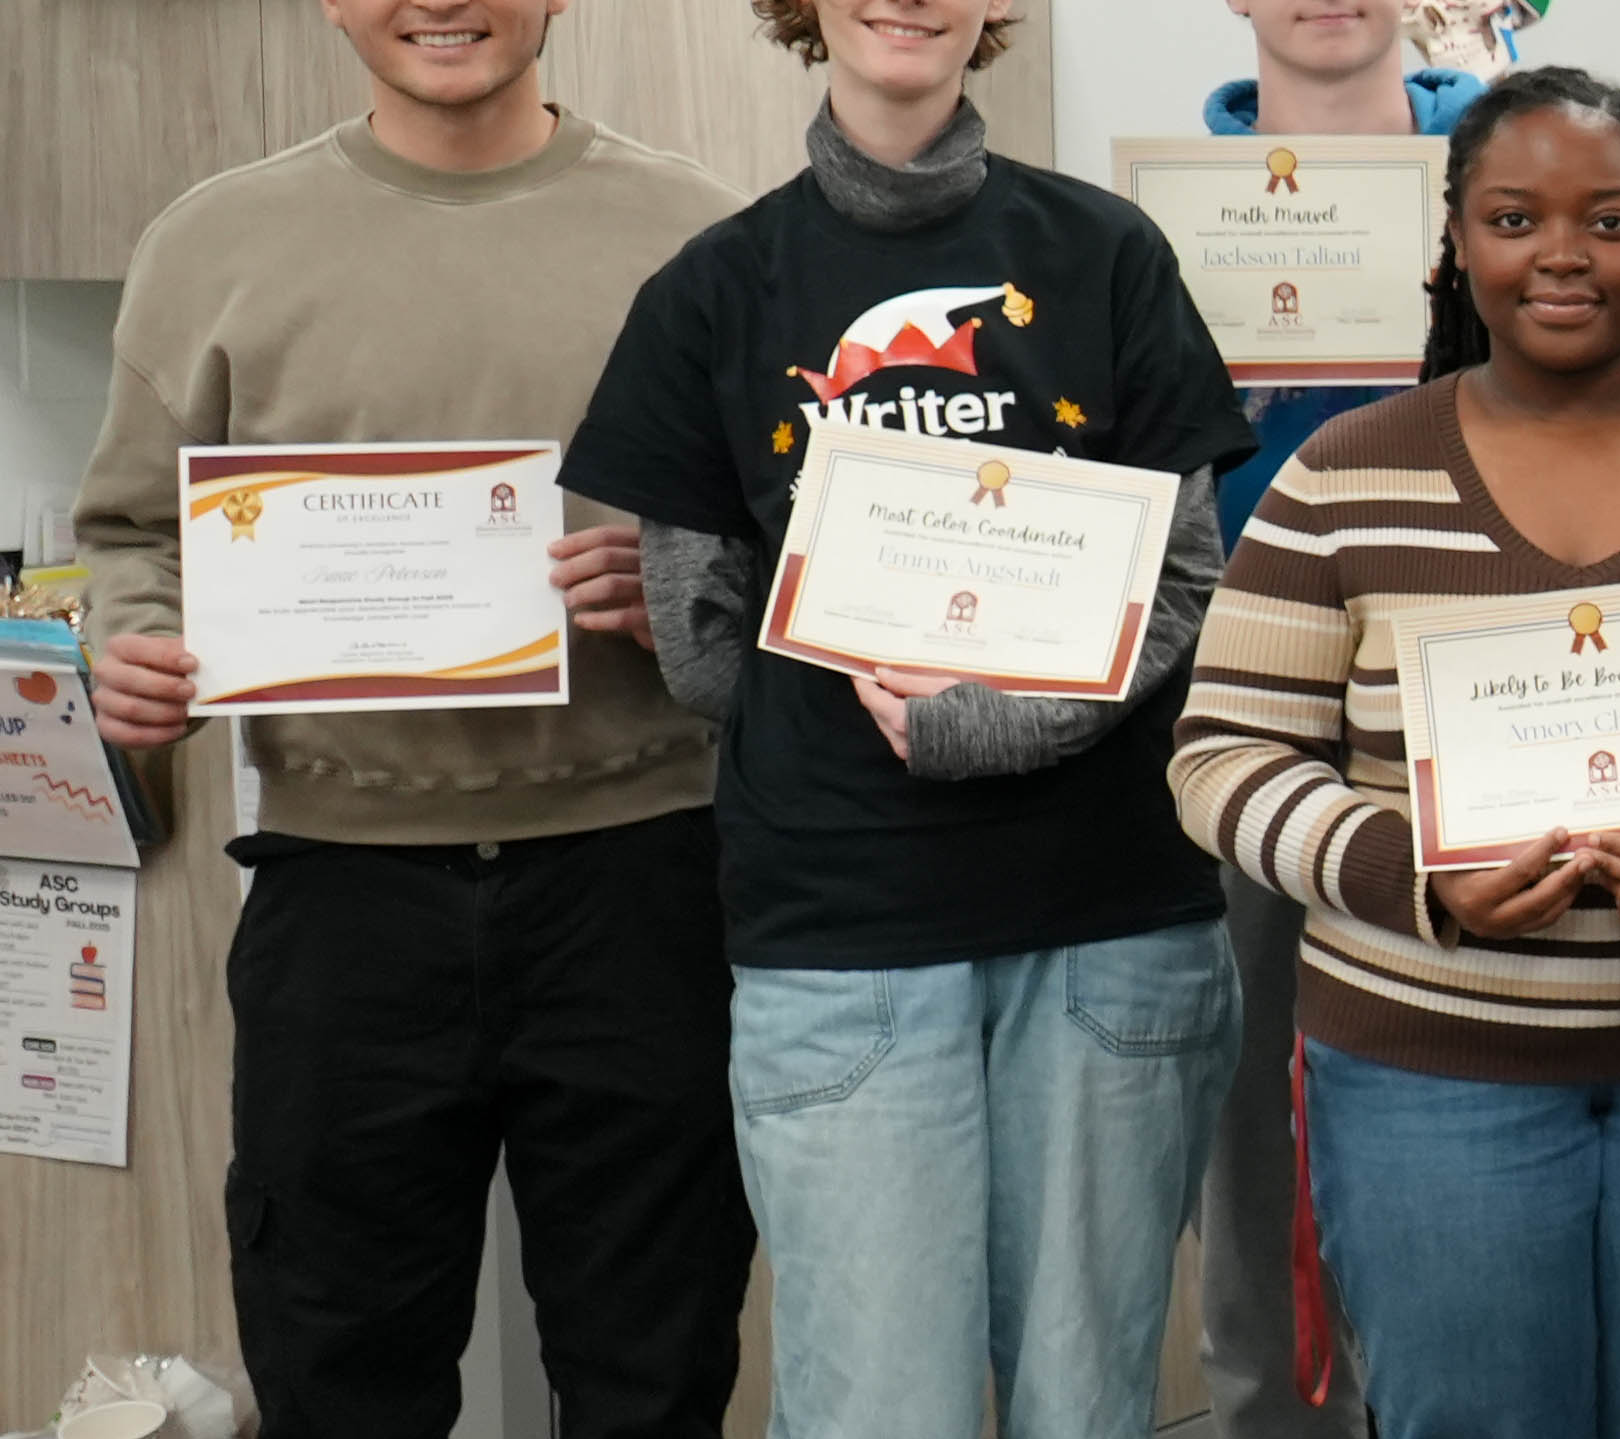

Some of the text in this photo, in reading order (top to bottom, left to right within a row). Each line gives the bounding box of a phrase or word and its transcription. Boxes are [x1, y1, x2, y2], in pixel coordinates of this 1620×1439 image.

[1221, 204, 1338, 225] Math Marvel
[1201, 247, 1287, 269] Jackson
[800, 386, 1015, 436] Writer
[303, 492, 443, 512] CERTIFICATE
[869, 502, 917, 527] Most
[922, 511, 971, 534] Color
[978, 517, 1087, 551] Coordinated
[1470, 674, 1529, 701] Likely
[1534, 673, 1550, 692] to
[1560, 670, 1586, 691] Be
[0, 715, 26, 736] UP
[40, 873, 79, 893] ASC
[0, 891, 120, 918] Study Groups
